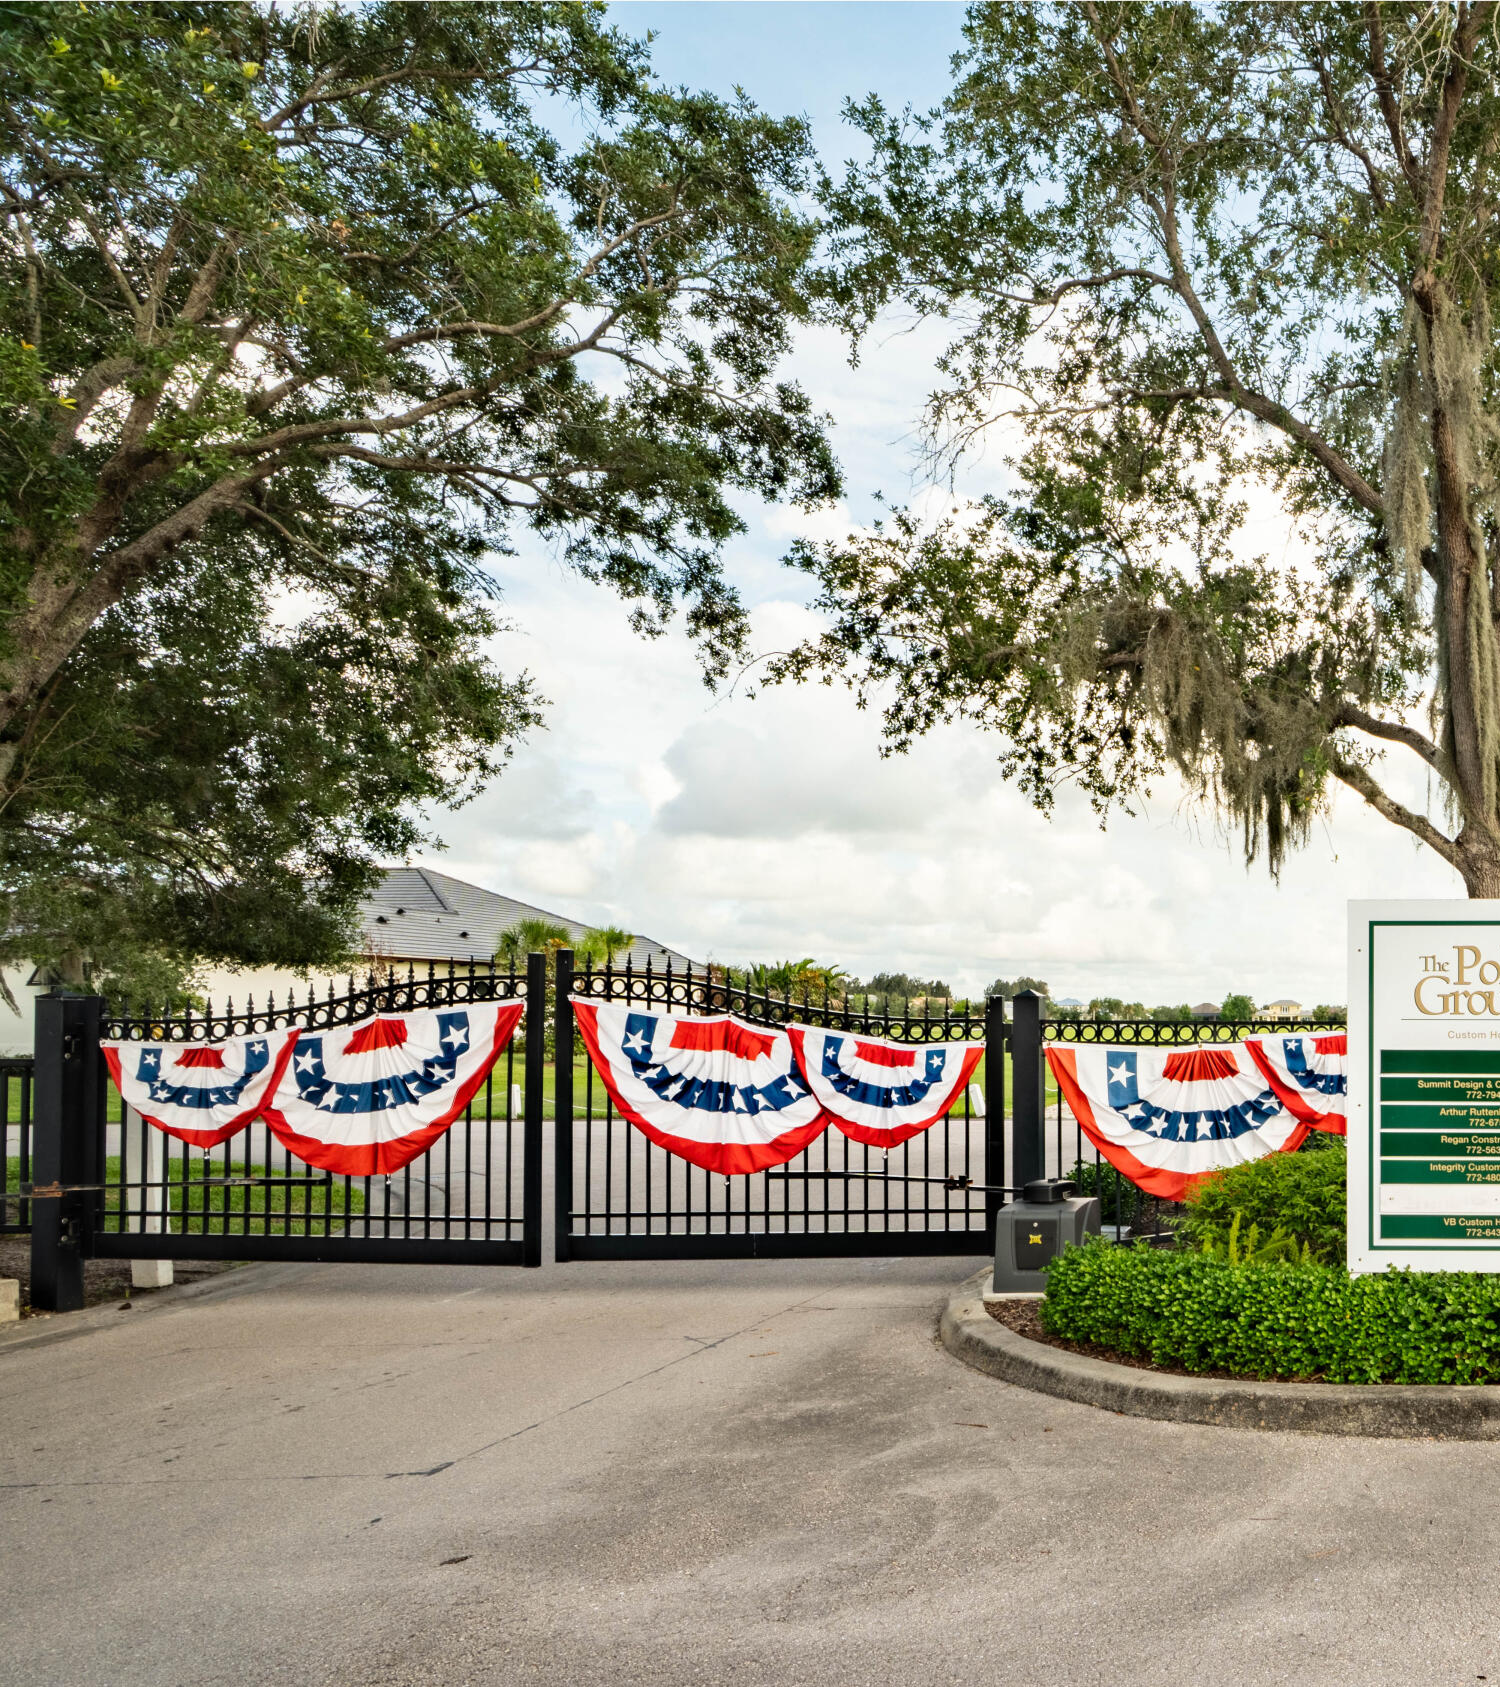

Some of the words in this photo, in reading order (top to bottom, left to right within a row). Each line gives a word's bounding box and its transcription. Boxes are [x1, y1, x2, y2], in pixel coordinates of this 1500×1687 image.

[1418, 954, 1450, 973] The
[1447, 1030, 1487, 1040] Custom
[1417, 1079, 1452, 1090] Summit
[1453, 1079, 1484, 1091] Design
[1486, 1080, 1493, 1089] &
[1439, 1107, 1468, 1117] Arthur
[1440, 1135, 1470, 1146] Regan
[1429, 1162, 1466, 1173] Integrity
[1443, 1217, 1457, 1227] VB
[1458, 1217, 1493, 1227] Custom
